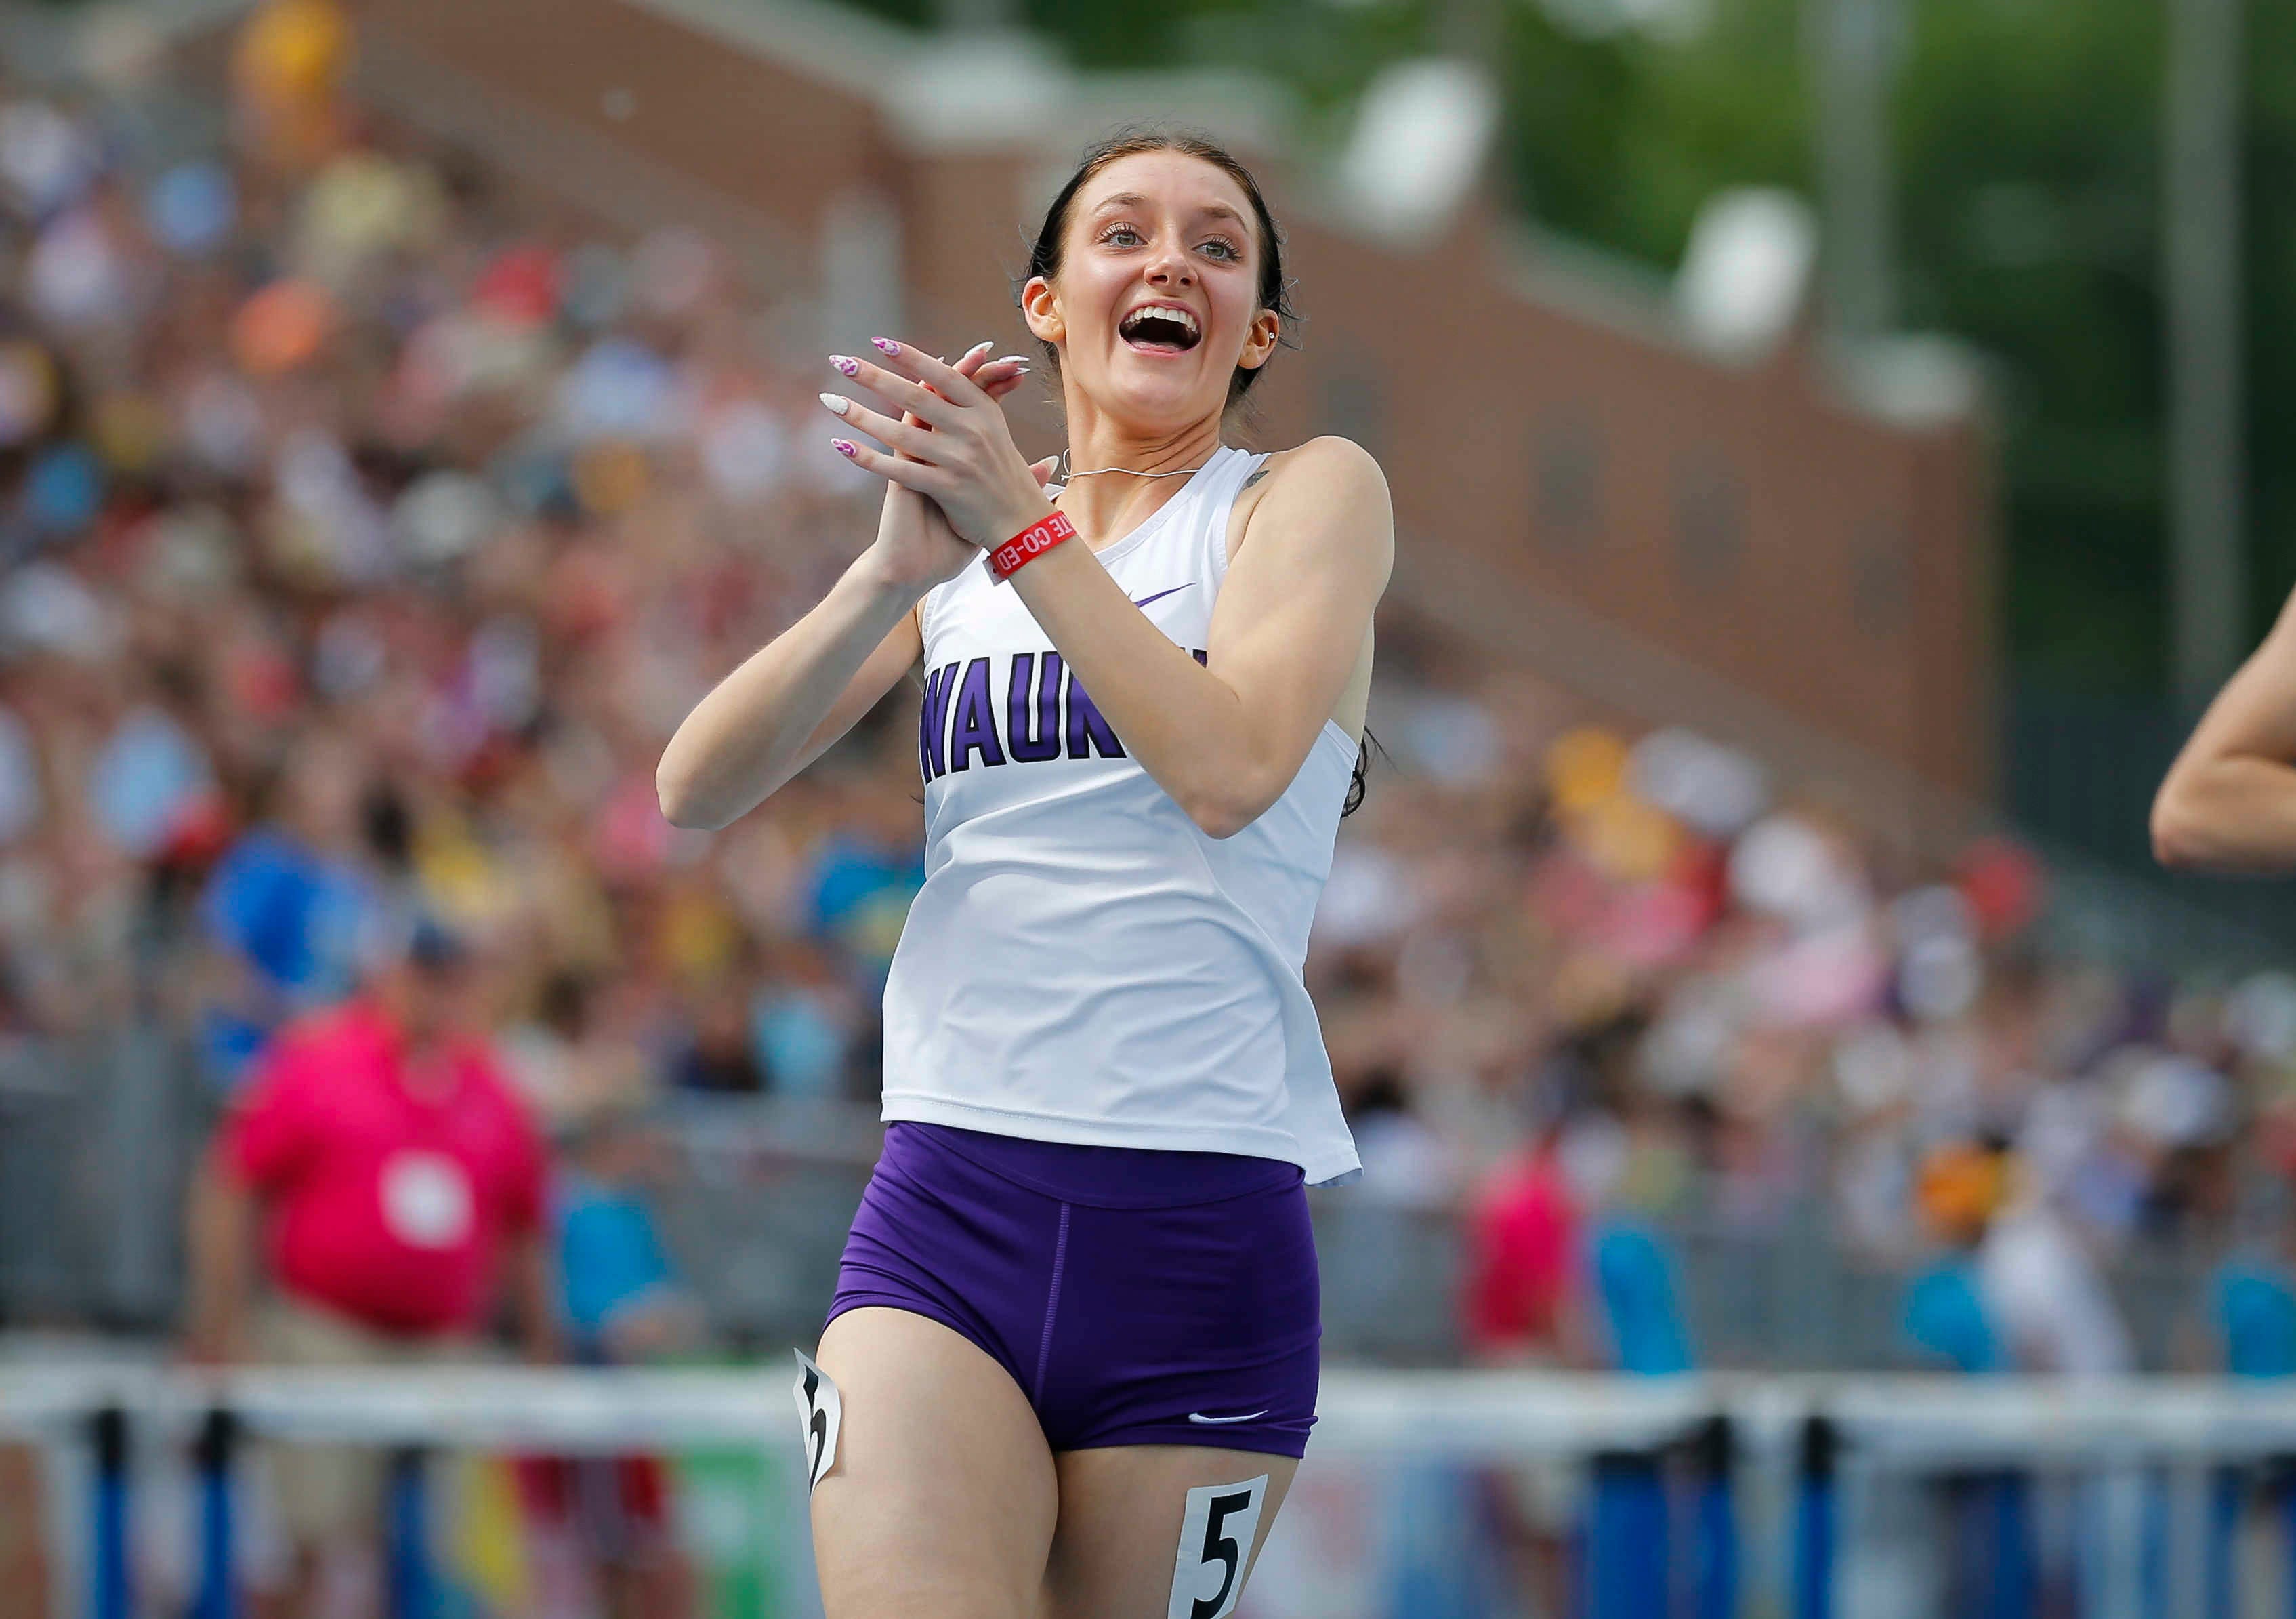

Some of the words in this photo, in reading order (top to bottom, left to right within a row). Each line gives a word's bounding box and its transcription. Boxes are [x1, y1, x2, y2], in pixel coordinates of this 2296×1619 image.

[997, 526, 1052, 571] CO-ED
[1048, 514, 1074, 538] TE
[919, 646, 1208, 785] WAUK
[1190, 1489, 1252, 1619] 5
